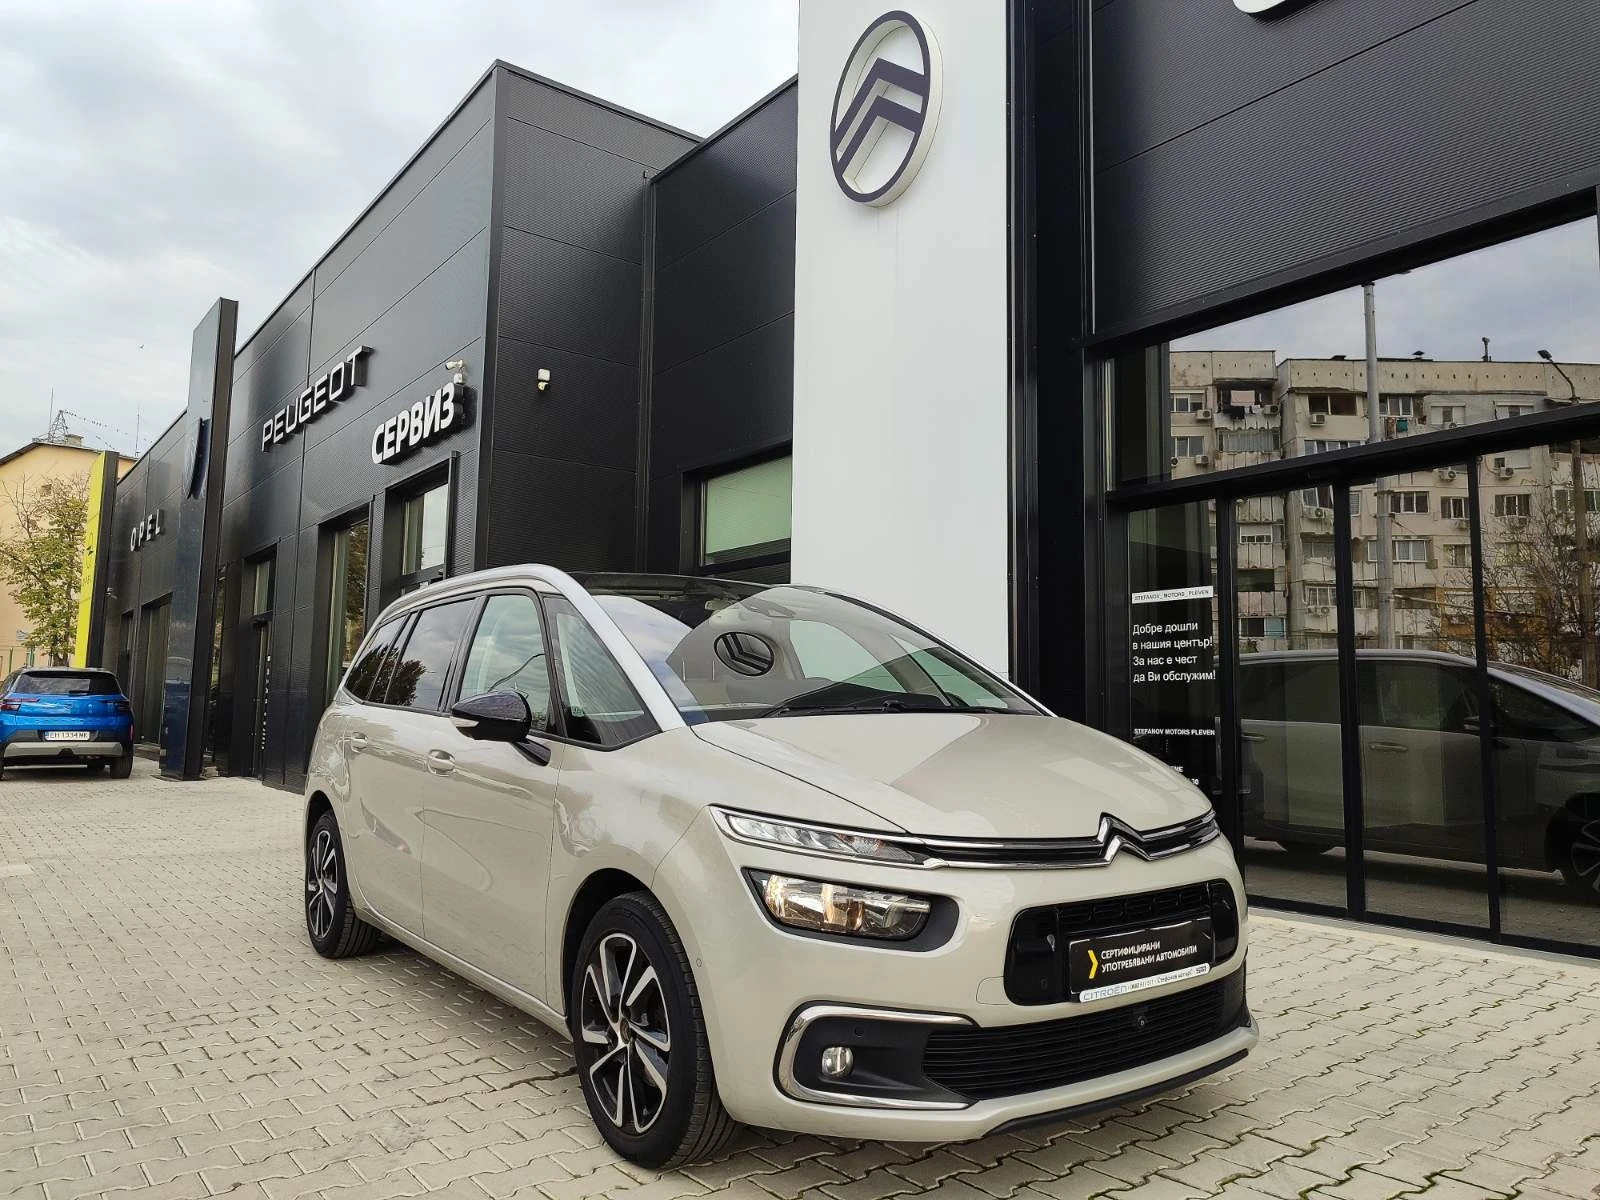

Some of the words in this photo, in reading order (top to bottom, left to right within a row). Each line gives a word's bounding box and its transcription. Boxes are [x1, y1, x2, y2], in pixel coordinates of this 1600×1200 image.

[261, 345, 374, 453] PEUGEOT
[371, 382, 464, 464] СЕРВИЗ
[130, 509, 161, 552] OPEL
[1132, 623, 1163, 636] Добре
[1164, 622, 1198, 634] дошли
[1132, 641, 1138, 650] в
[1140, 640, 1172, 650] нашия
[1173, 635, 1213, 650] център!
[1132, 655, 1145, 666] За
[1147, 657, 1165, 665] нас
[1166, 657, 1173, 665] е
[1174, 655, 1198, 664] чест
[1133, 673, 1146, 683] да
[1147, 671, 1161, 682] Ви
[1162, 669, 1216, 683] обслужим!
[1190, 728, 1216, 736] PLEVEN
[1100, 940, 1161, 960] СЕРТИФИЦИРАНИ
[1101, 956, 1155, 973] УПОТРЕБЯВАНИ
[1155, 944, 1198, 963] АВТОМОБИЛИ
